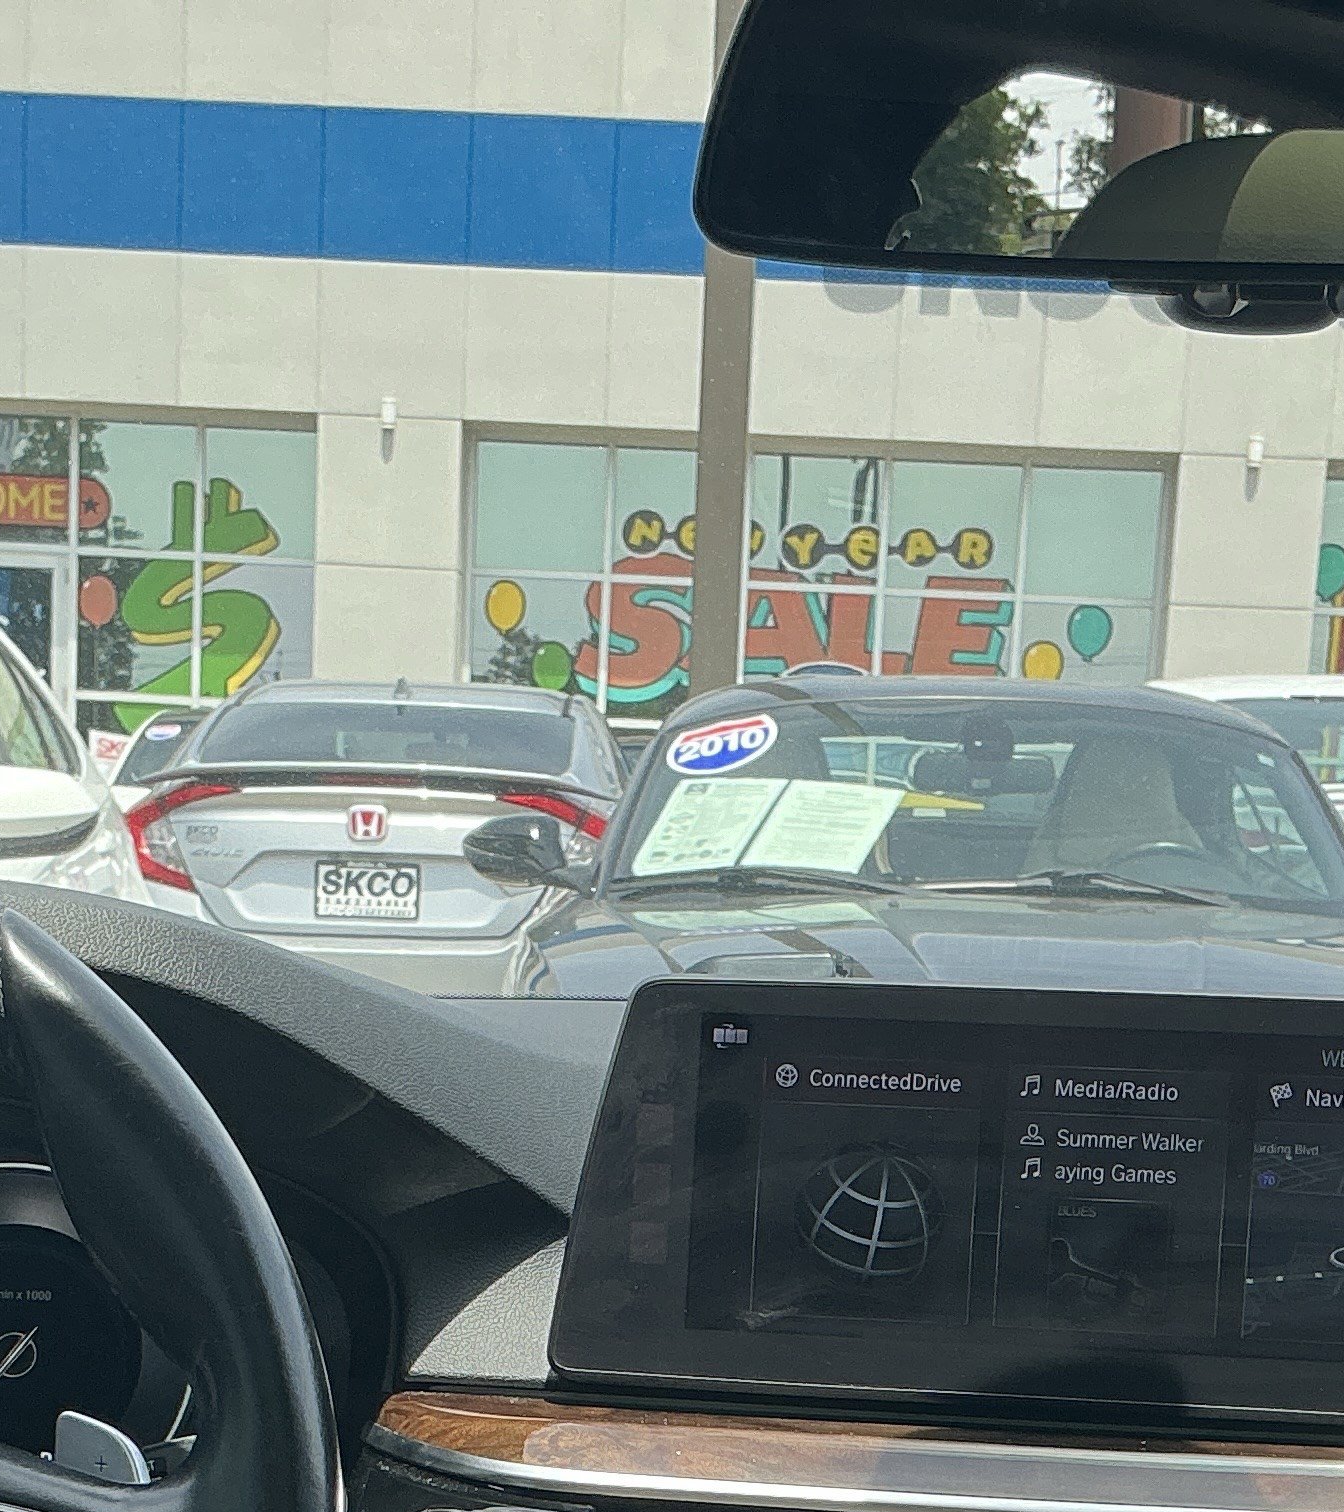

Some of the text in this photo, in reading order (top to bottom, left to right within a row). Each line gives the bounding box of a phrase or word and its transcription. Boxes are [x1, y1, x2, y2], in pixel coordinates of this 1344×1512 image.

[677, 727, 765, 764] 2010
[322, 867, 416, 898] SKCO
[809, 1068, 962, 1093] ConnectedDrive
[1054, 1078, 1179, 1102] Media/Radio
[1056, 1129, 1204, 1153] Summer Walker
[1054, 1163, 1177, 1185] aying Games
